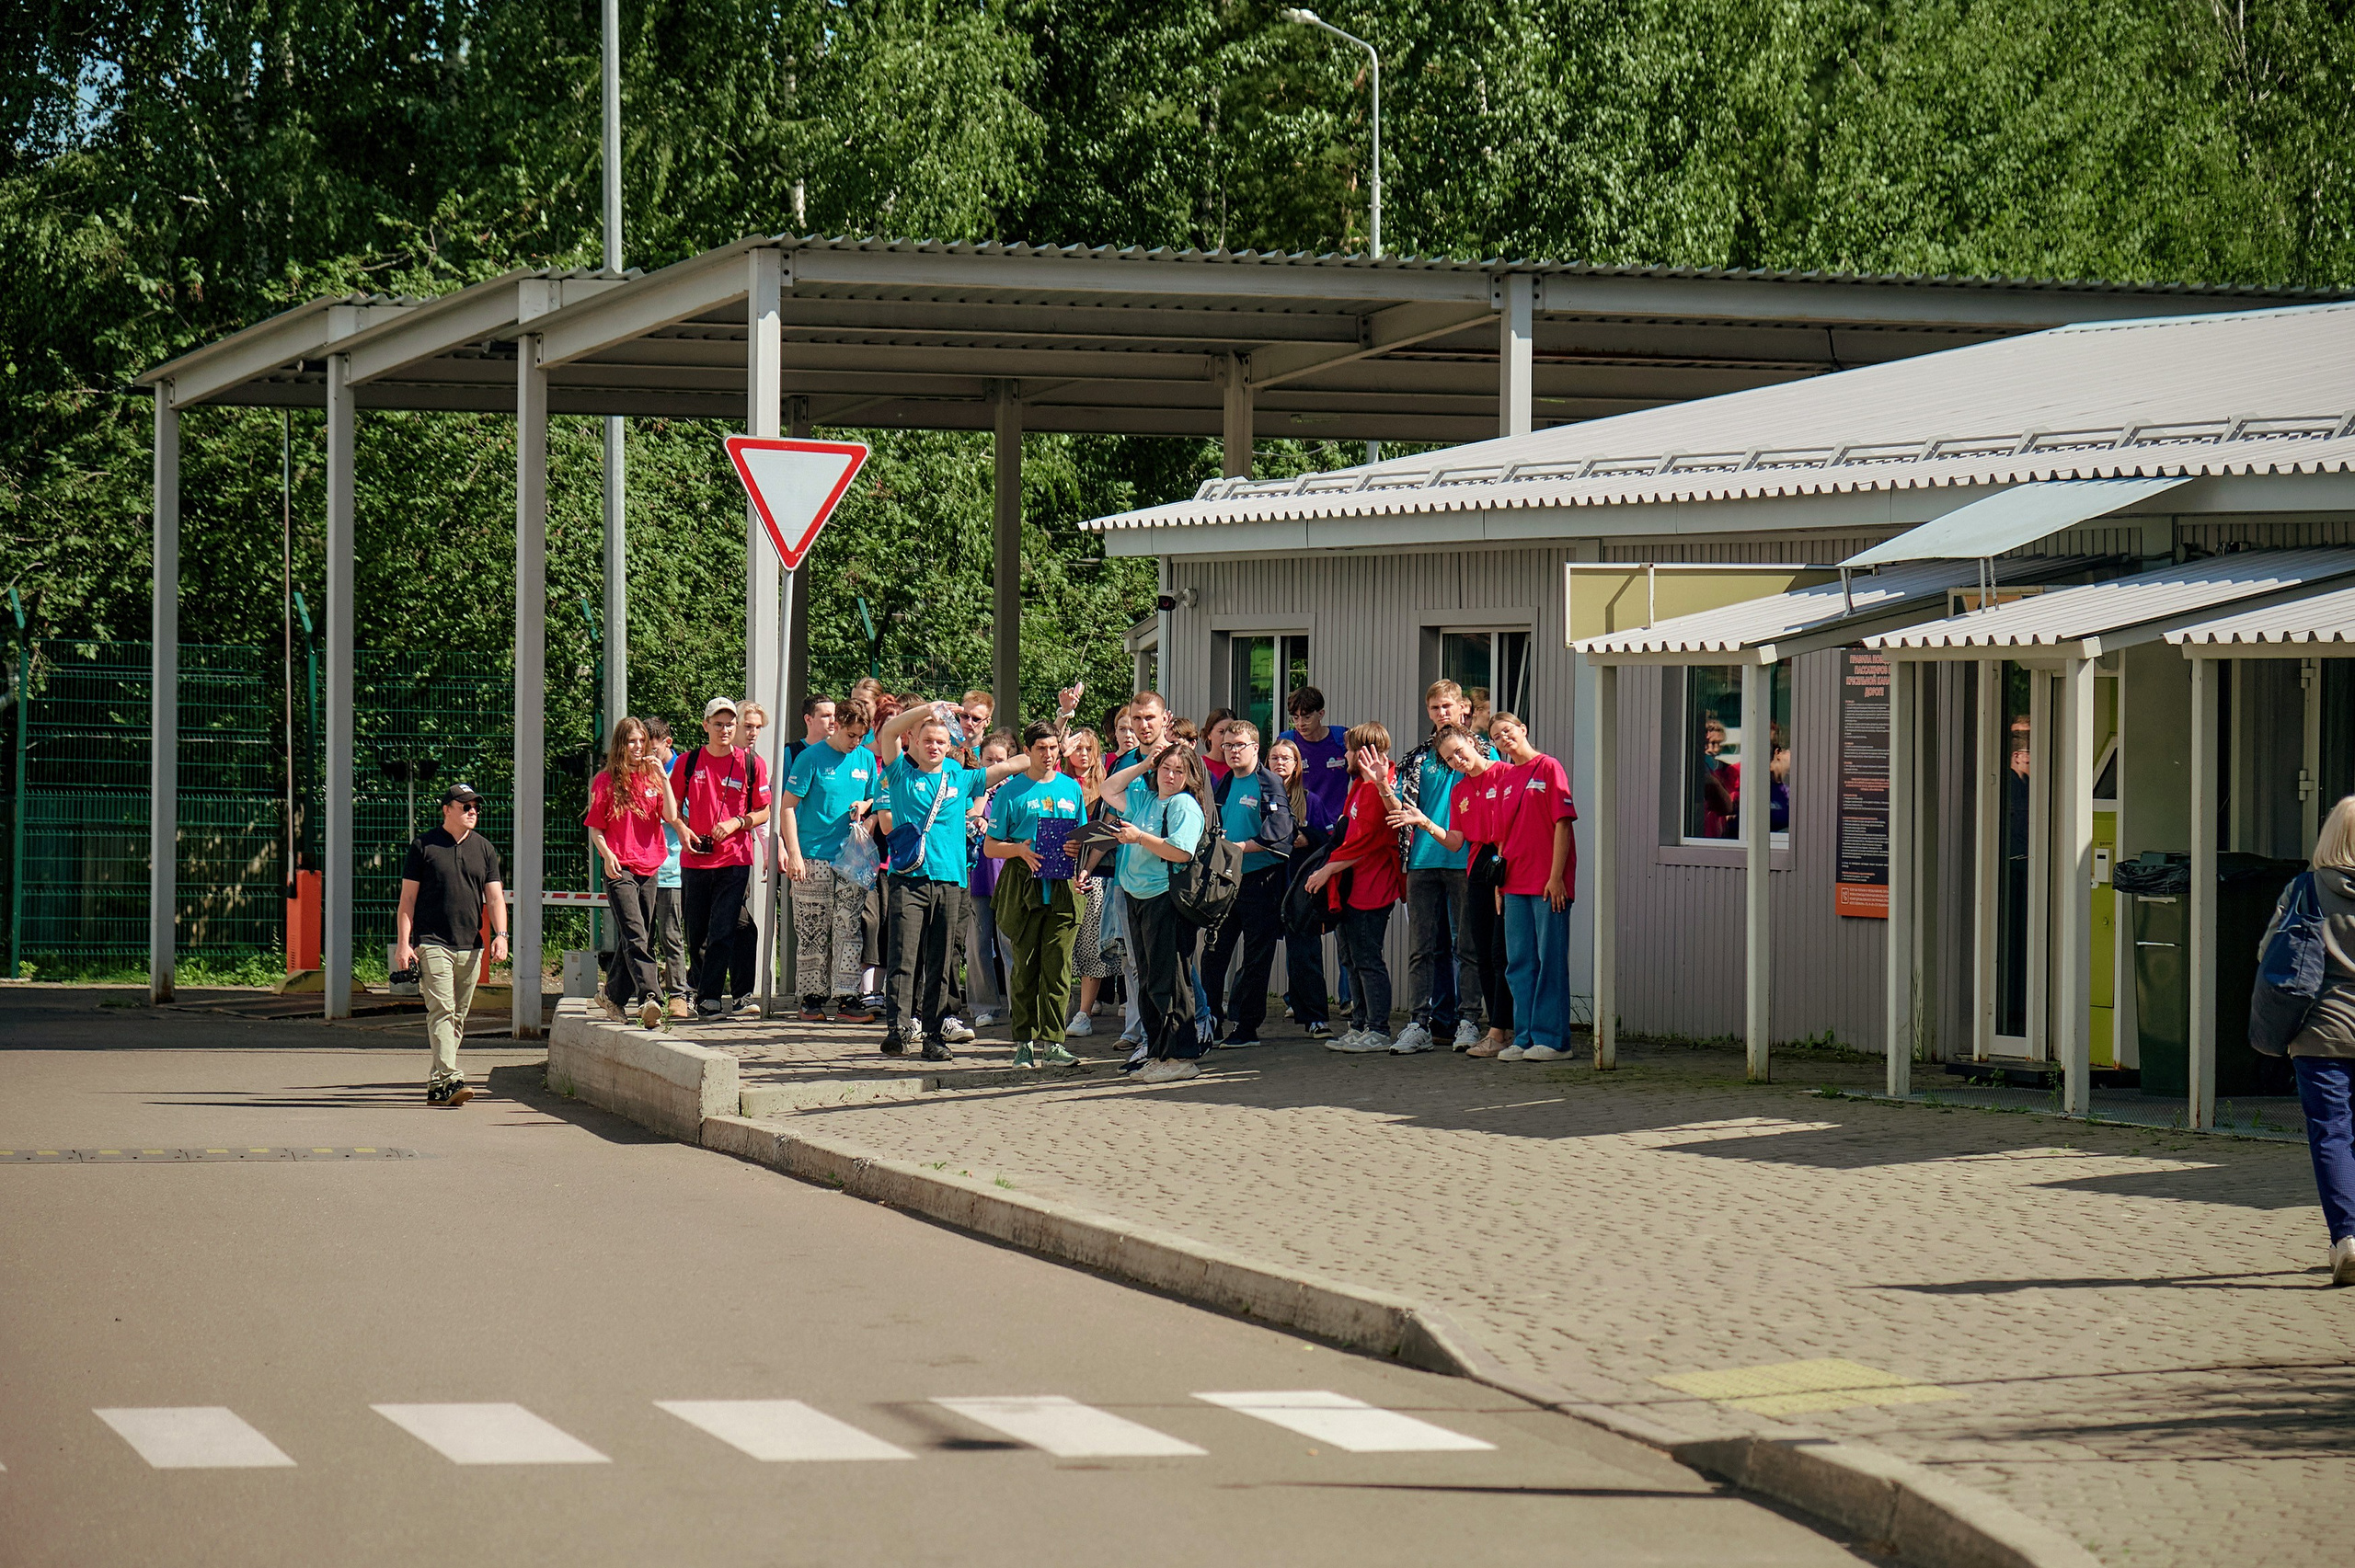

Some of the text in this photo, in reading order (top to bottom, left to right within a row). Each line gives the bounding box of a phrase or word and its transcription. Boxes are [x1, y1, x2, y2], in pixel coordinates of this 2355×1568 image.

[1849, 654, 1872, 664] ПРАВИЛА
[1854, 665, 1888, 675] ПАССАЖИРОВ
[1845, 674, 1877, 686] КРЕСЕЛЬНОЙ
